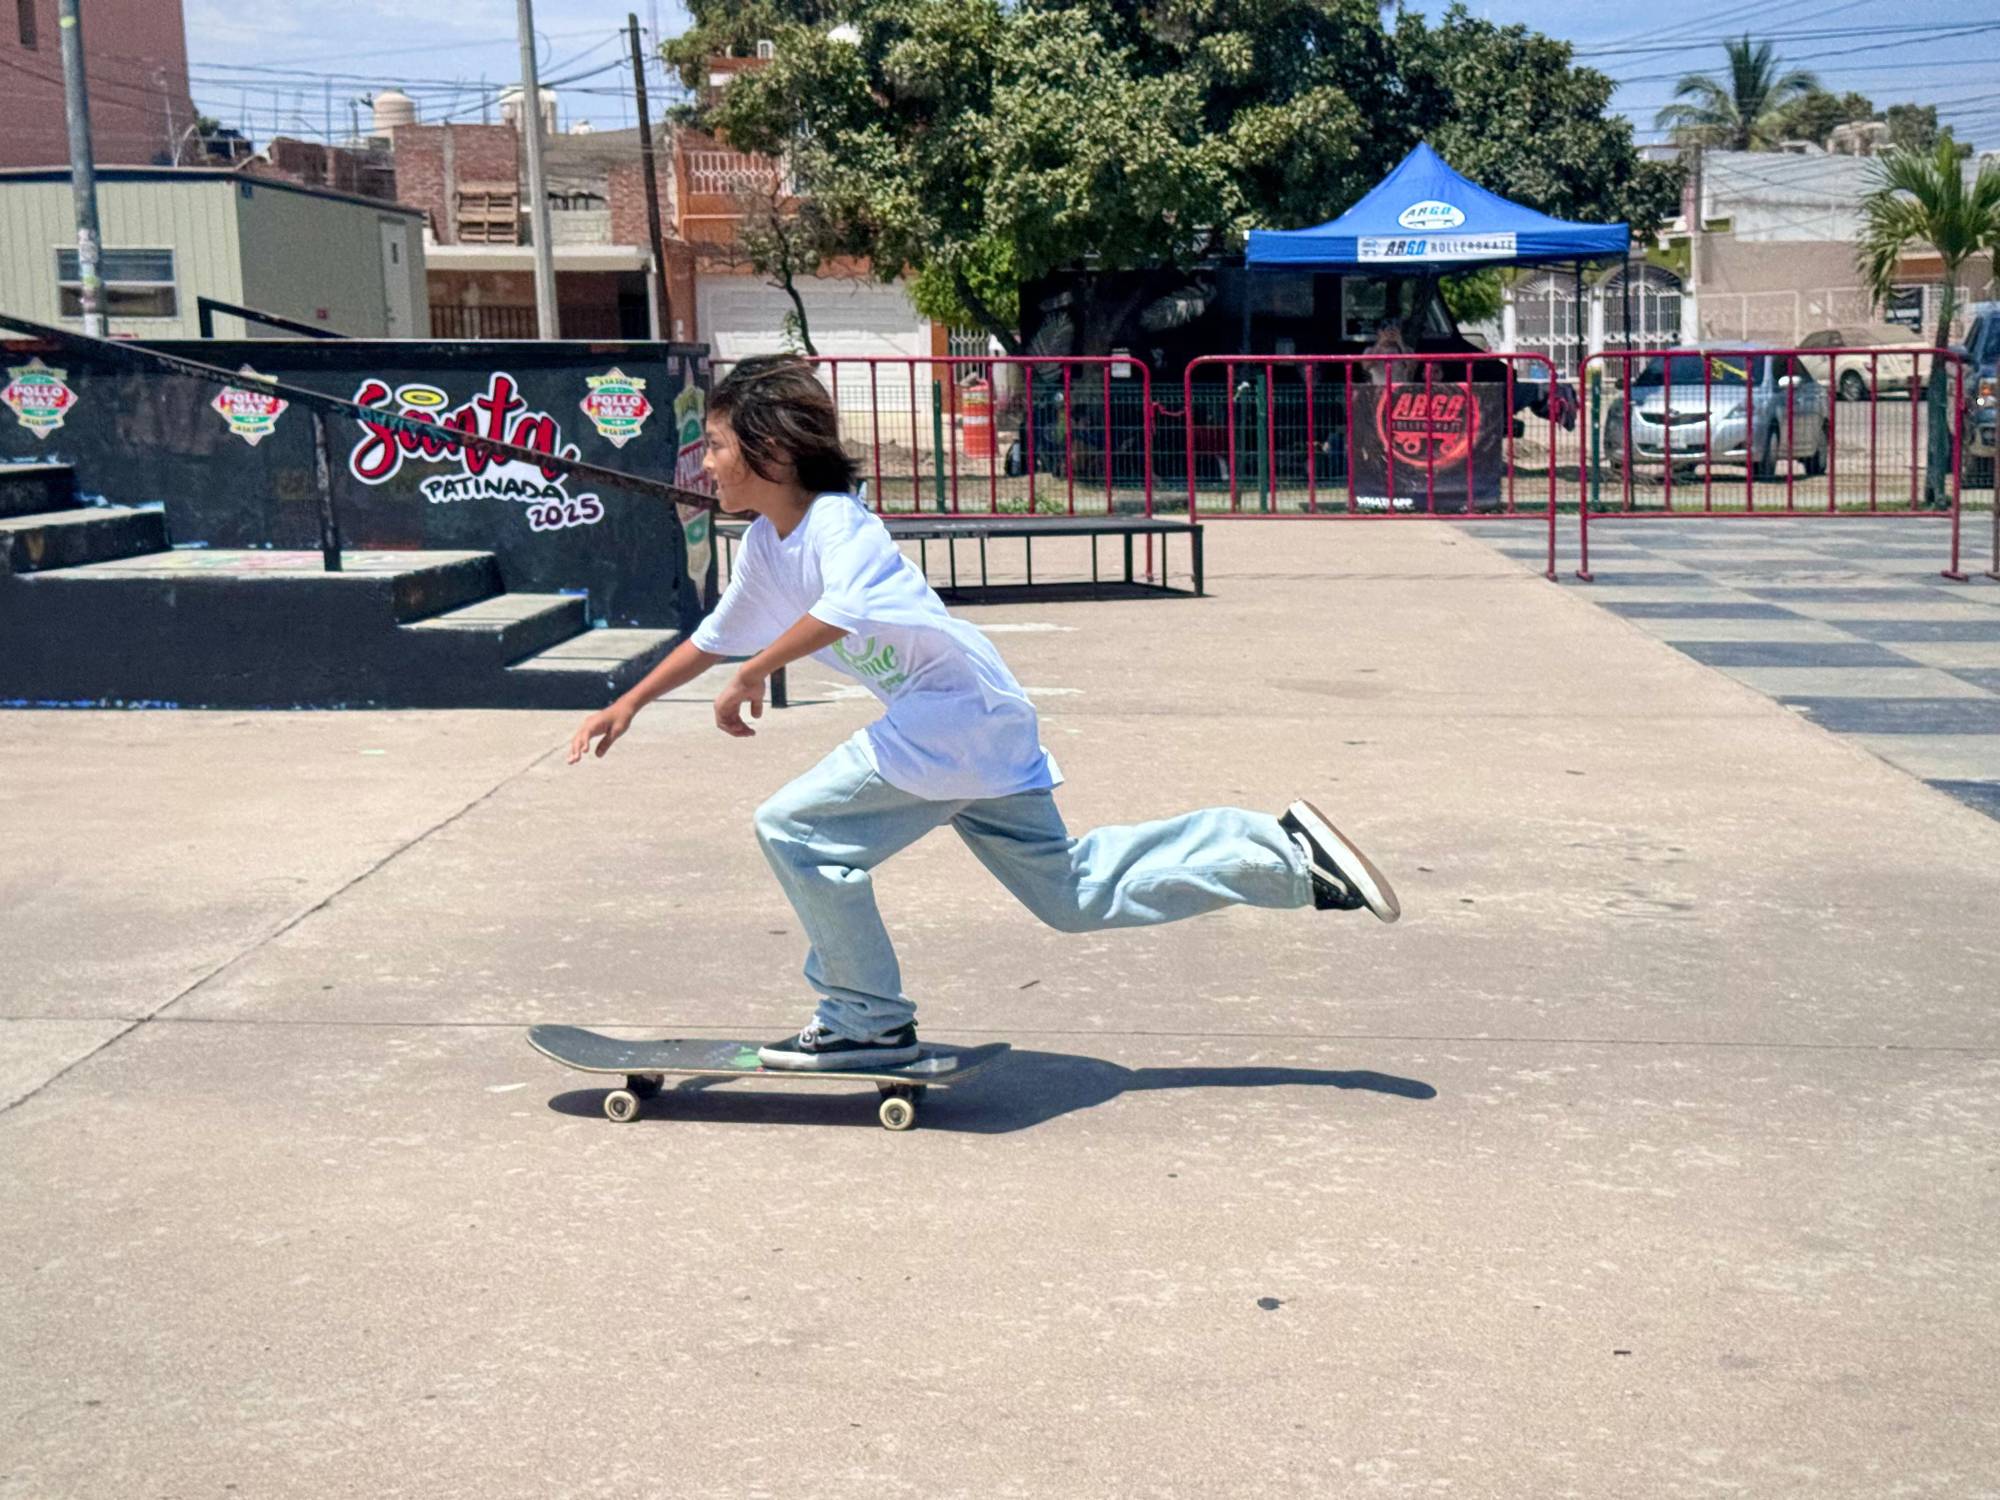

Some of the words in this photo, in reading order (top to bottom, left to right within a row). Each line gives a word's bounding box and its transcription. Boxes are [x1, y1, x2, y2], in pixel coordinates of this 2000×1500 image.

[1405, 206, 1452, 218] ARGO
[1384, 240, 1428, 257] ARGO
[13, 385, 64, 399] POLLO
[590, 395, 642, 408] POLLO
[1391, 393, 1465, 419] ARGO
[600, 404, 634, 417] MAZ
[354, 375, 576, 480] Santa
[424, 476, 563, 500] PATINADA
[531, 497, 600, 527] 2025
